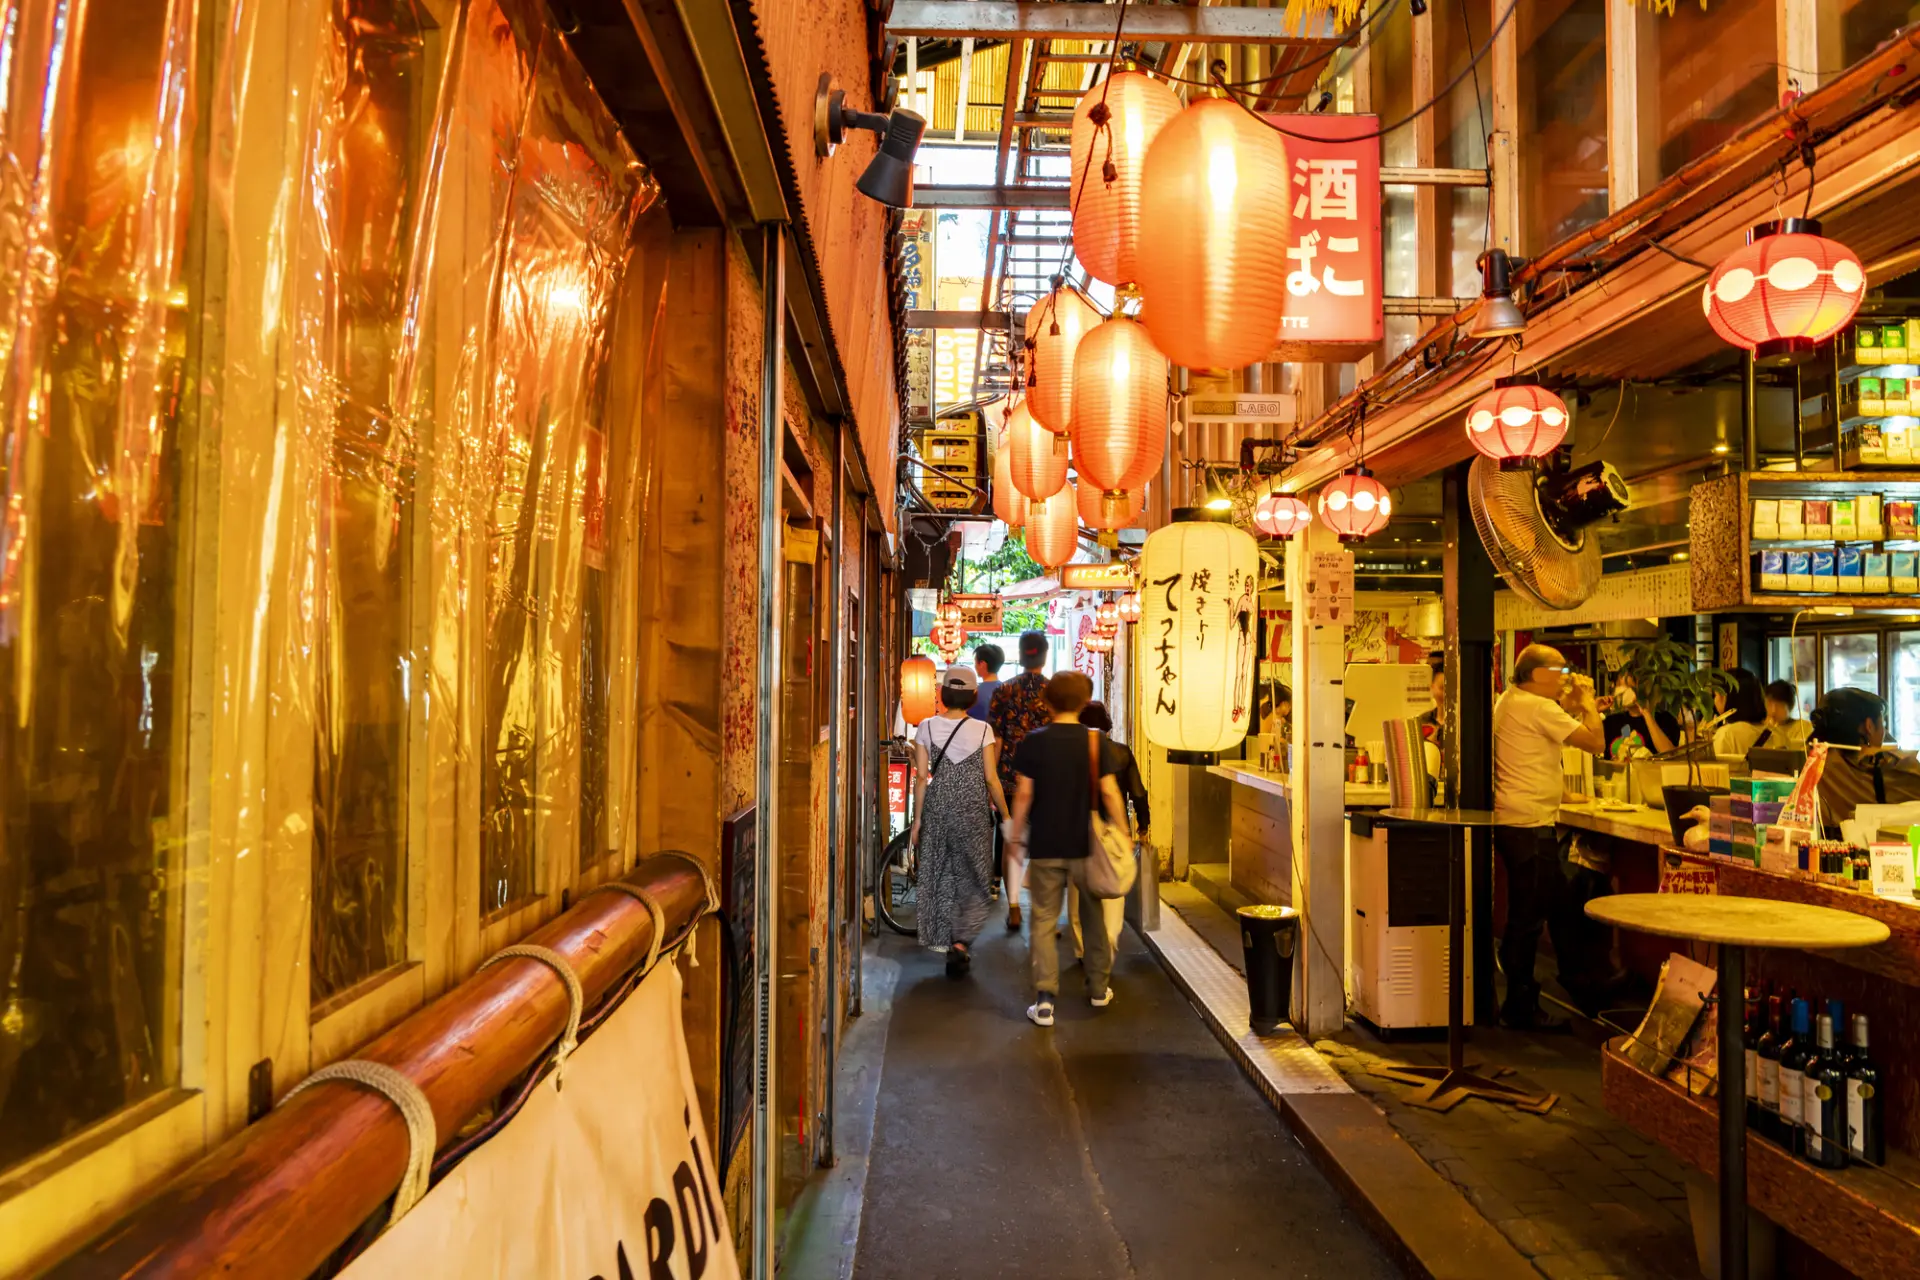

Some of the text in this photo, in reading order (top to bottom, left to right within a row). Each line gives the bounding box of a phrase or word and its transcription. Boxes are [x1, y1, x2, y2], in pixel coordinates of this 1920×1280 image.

[1292, 158, 1358, 221] 酒
[1238, 403, 1278, 414] LABO
[1153, 573, 1183, 716] てっちゃん
